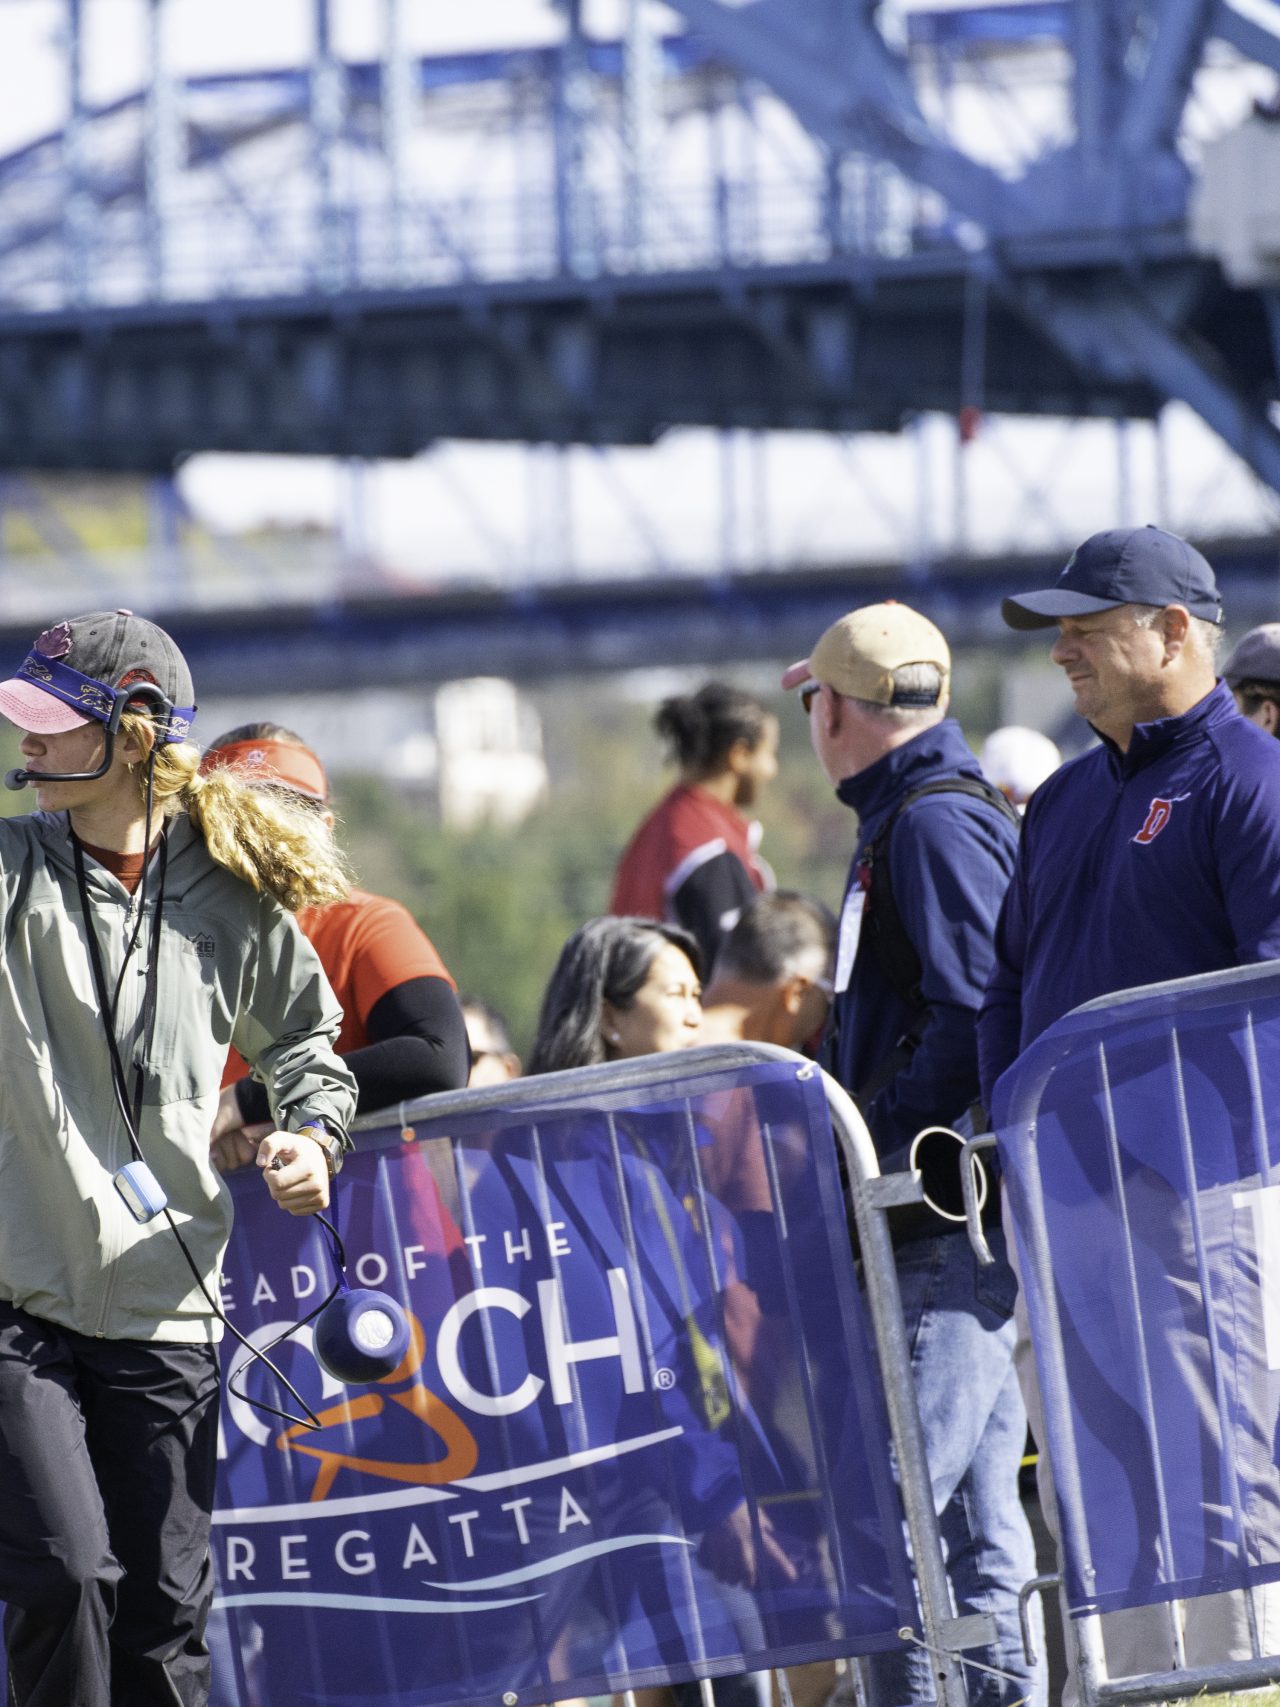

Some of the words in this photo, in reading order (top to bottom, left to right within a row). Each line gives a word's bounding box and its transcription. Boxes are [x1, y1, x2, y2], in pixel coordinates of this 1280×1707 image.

[1131, 797, 1175, 845] D
[356, 1245, 427, 1288] OF
[464, 1222, 572, 1269] THE
[226, 1486, 590, 1581] REGATTA
